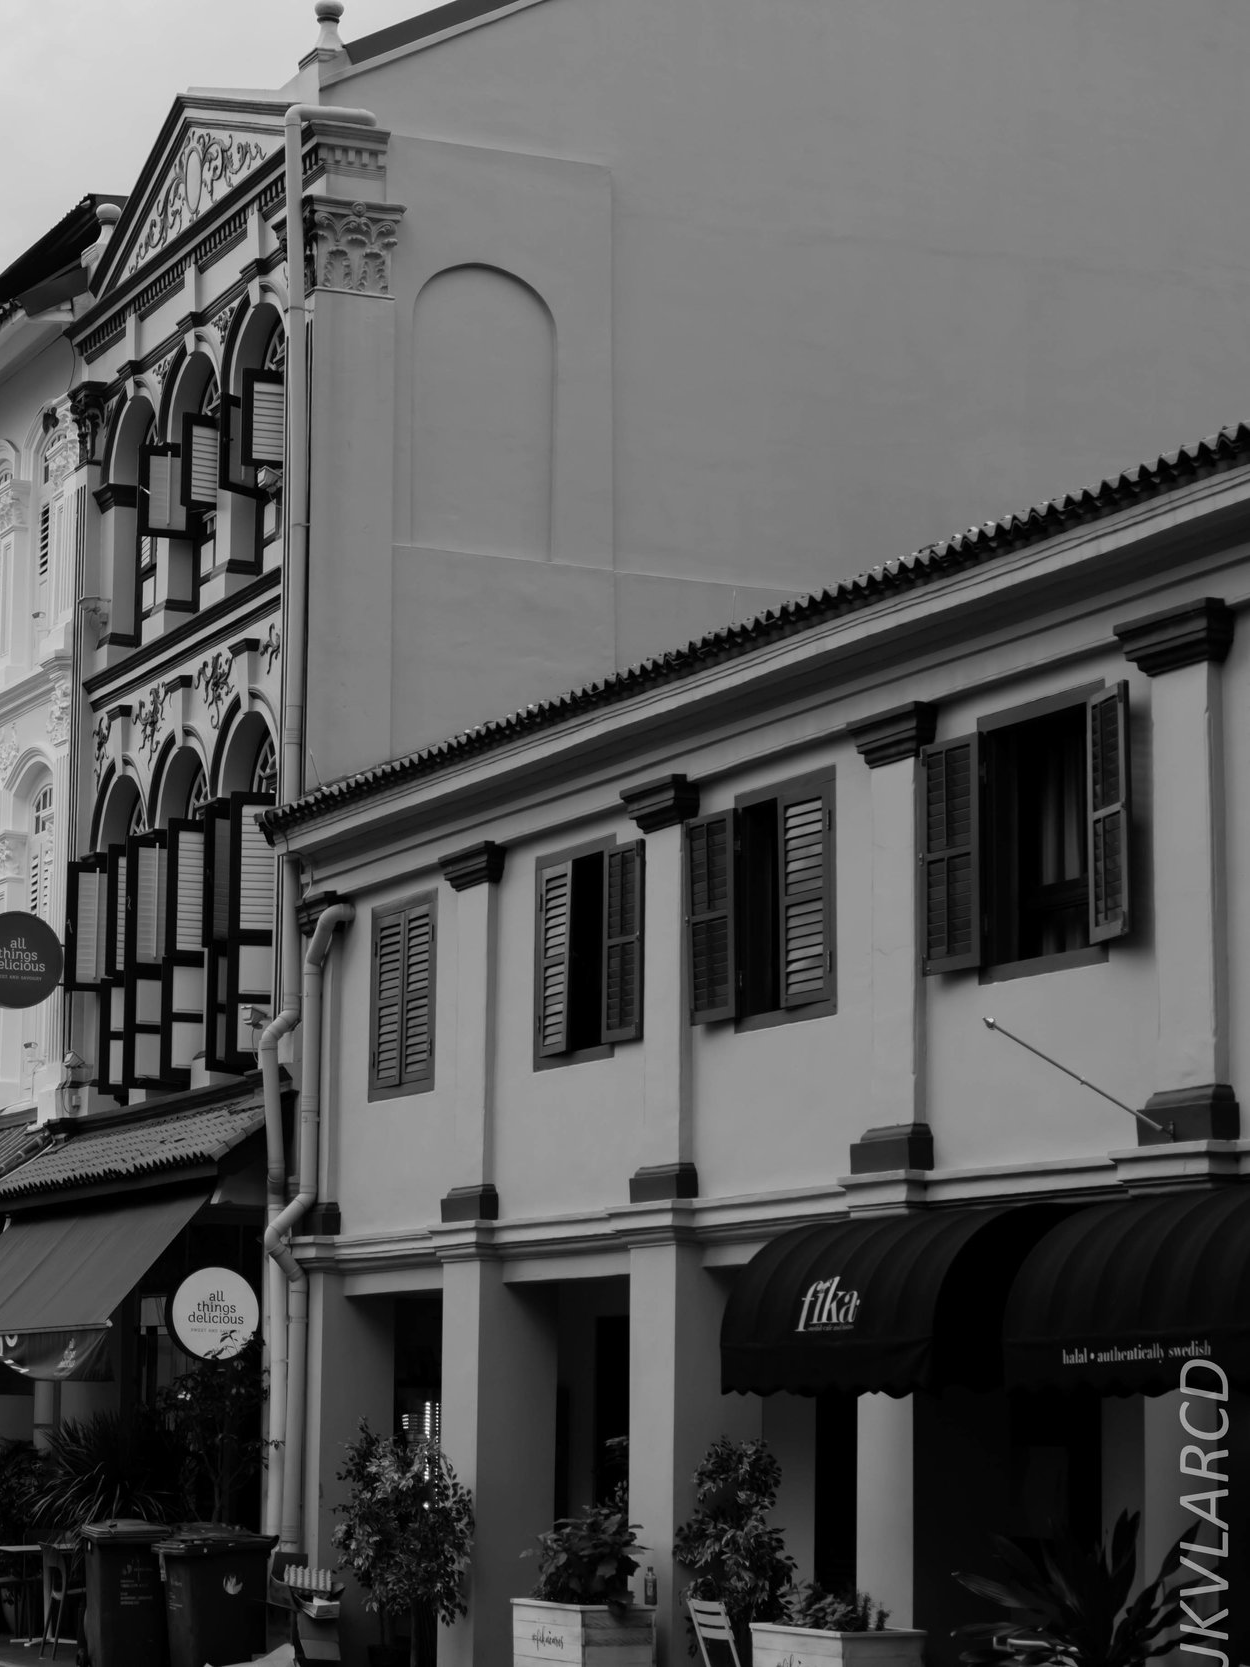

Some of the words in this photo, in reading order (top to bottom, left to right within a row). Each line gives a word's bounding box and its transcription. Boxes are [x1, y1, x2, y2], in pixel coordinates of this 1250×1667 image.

[10, 937, 27, 949] all
[209, 1290, 225, 1302] all
[197, 1301, 237, 1315] things
[794, 1275, 860, 1332] fika
[188, 1311, 244, 1325] delicious
[1062, 1347, 1088, 1365] halal
[1097, 1342, 1165, 1364] authentically
[1168, 1339, 1212, 1358] swedish
